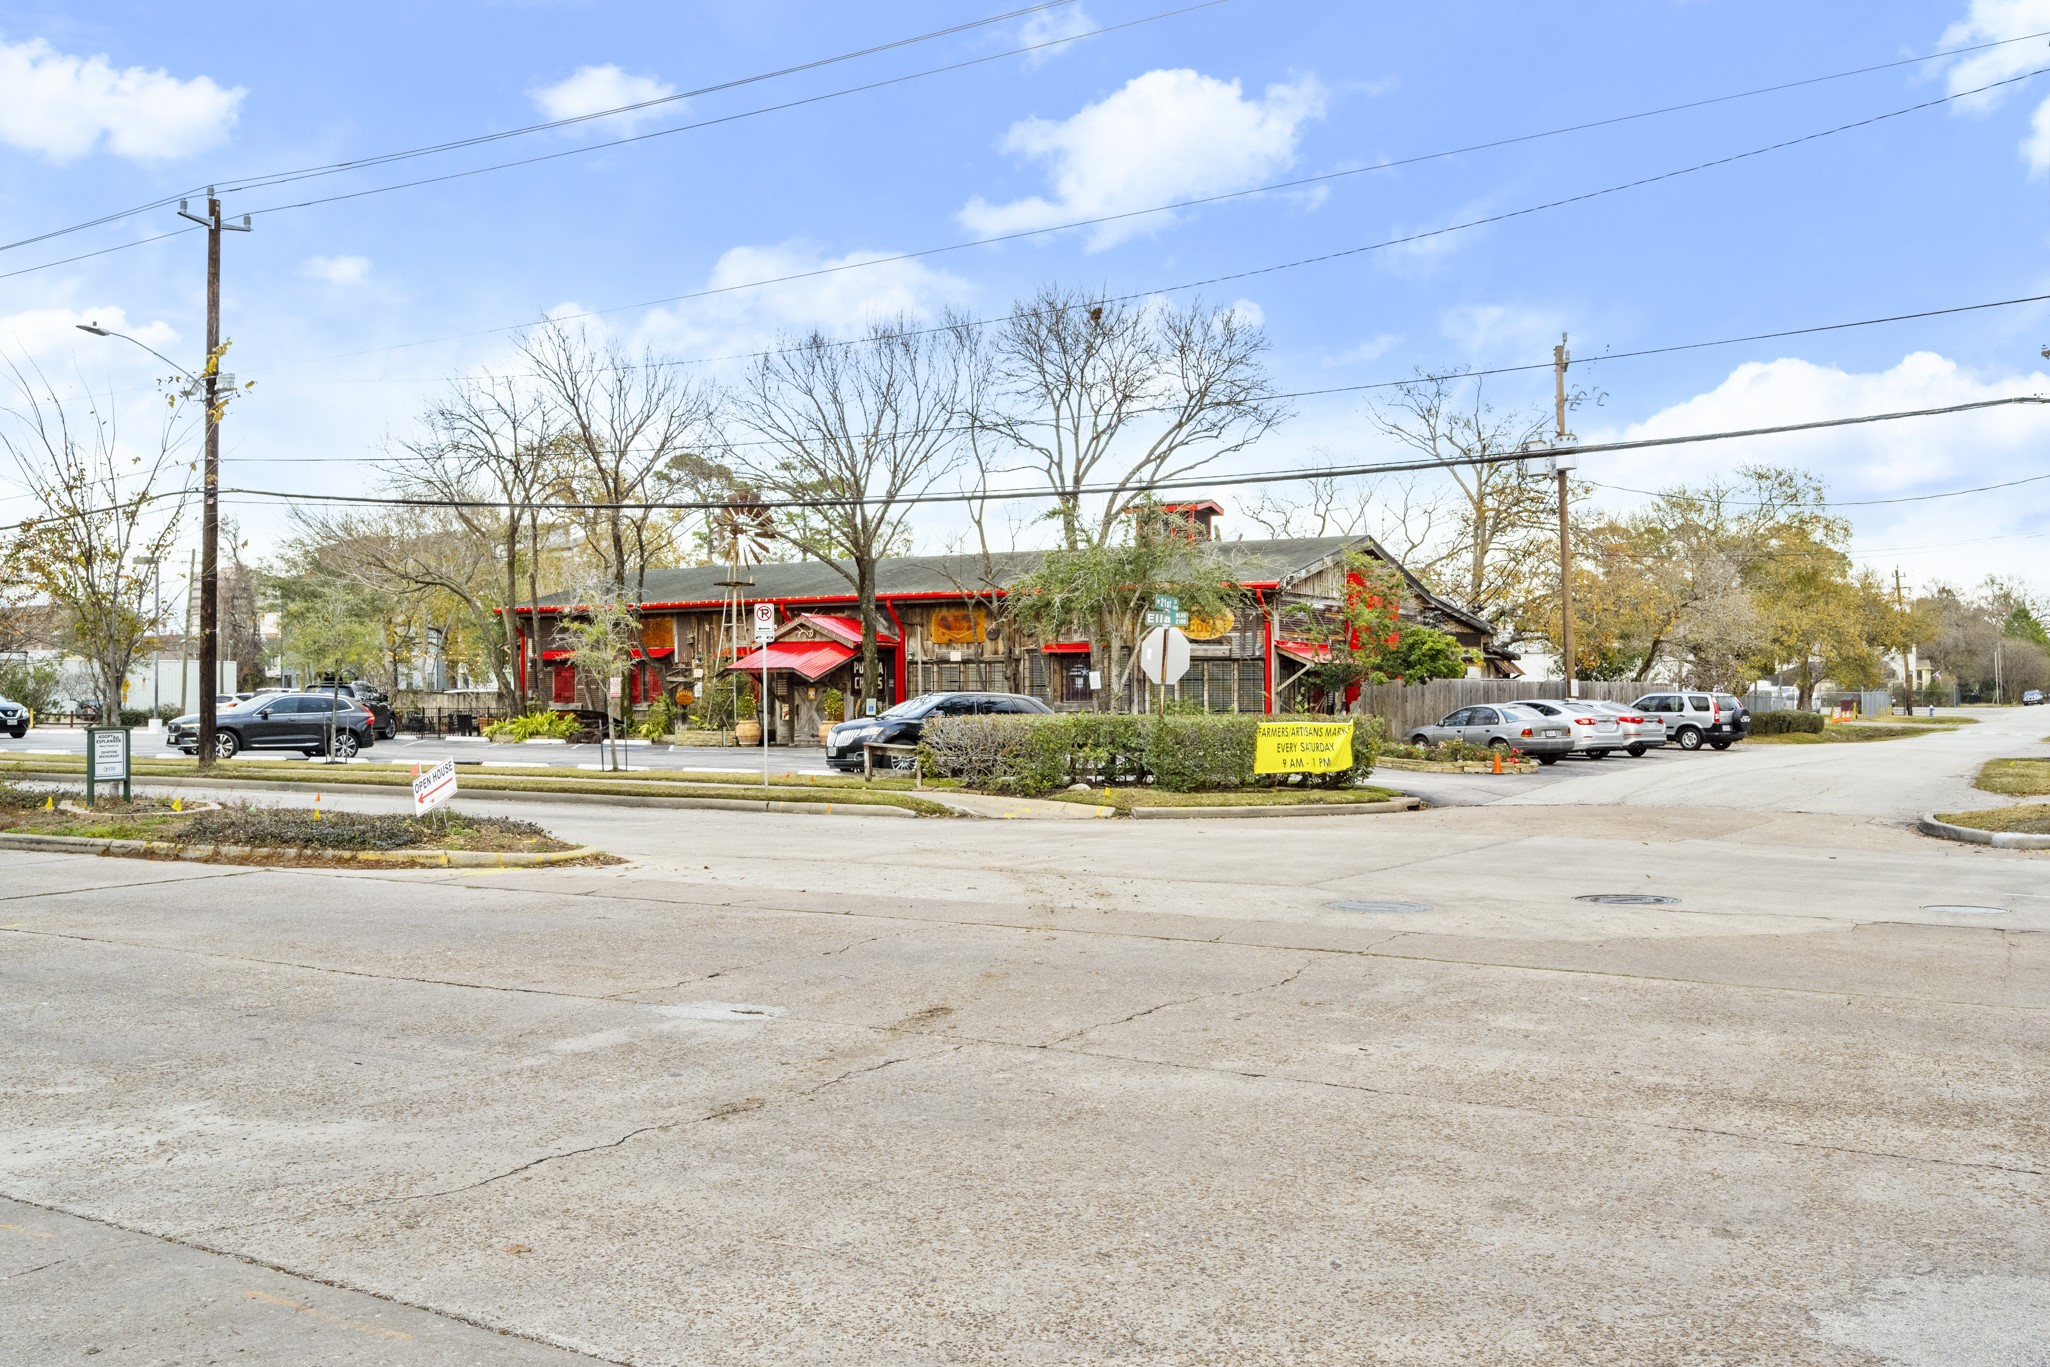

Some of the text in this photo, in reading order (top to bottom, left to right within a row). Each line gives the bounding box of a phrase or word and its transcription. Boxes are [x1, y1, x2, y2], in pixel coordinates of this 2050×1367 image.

[1160, 598, 1172, 609] 21st
[1147, 613, 1171, 624] Ella
[1276, 742, 1335, 753] EVERY SATURDAY
[1282, 758, 1287, 769] 9
[1289, 758, 1304, 768] AM
[1312, 758, 1316, 768] 1
[1318, 757, 1331, 767] PM
[415, 760, 452, 793] OPEN HOUSE
